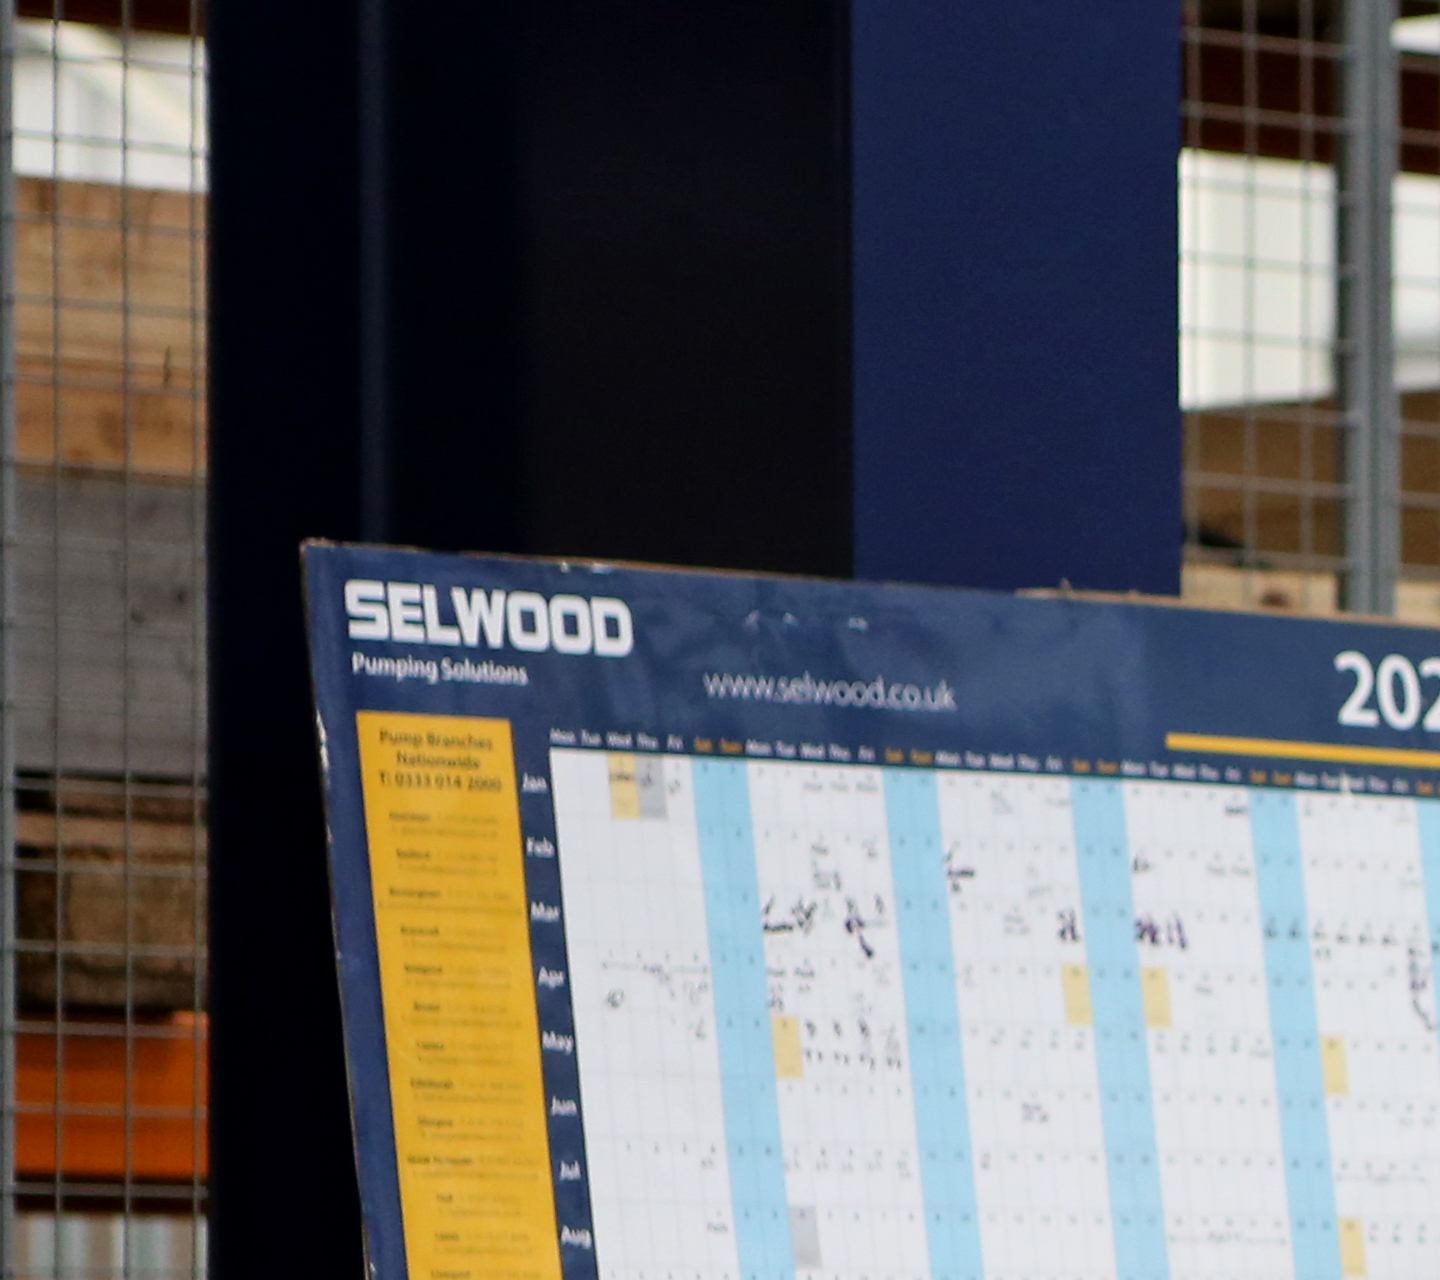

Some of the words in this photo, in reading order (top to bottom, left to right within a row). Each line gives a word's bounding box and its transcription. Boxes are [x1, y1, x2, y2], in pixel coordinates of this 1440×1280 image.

[344, 580, 634, 659] SELWOOD
[352, 650, 438, 685] Pumping
[441, 656, 528, 685] Solutions
[703, 672, 955, 711] www.selwood.co.uk
[522, 773, 548, 792] Jan
[526, 838, 555, 857] Feb
[531, 902, 561, 920] Mar
[537, 967, 566, 988] Apr
[542, 1030, 574, 1054] May
[551, 1098, 578, 1116] Jun
[559, 1161, 580, 1179] Jul
[561, 1225, 591, 1249] Aug
